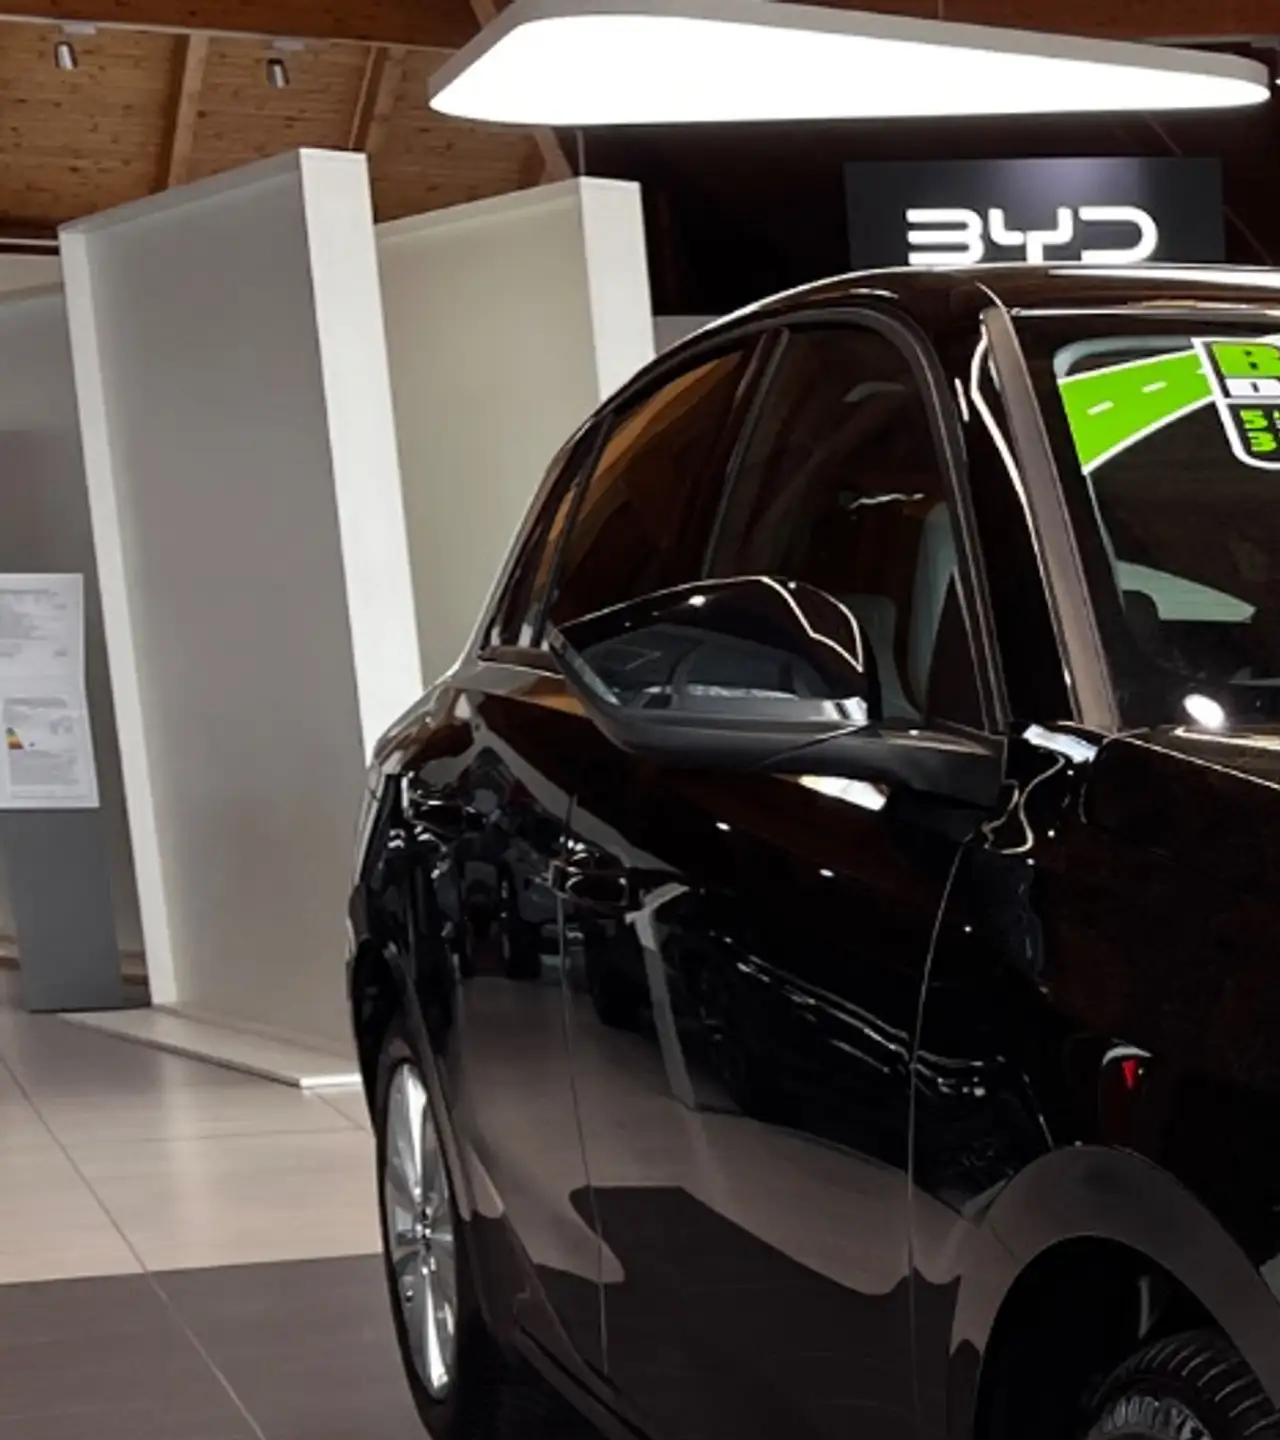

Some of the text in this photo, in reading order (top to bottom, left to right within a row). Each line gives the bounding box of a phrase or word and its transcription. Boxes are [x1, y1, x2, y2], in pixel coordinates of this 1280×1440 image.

[905, 206, 1159, 265] BYD
[1240, 409, 1268, 430] 5
[1247, 431, 1277, 453] 3
